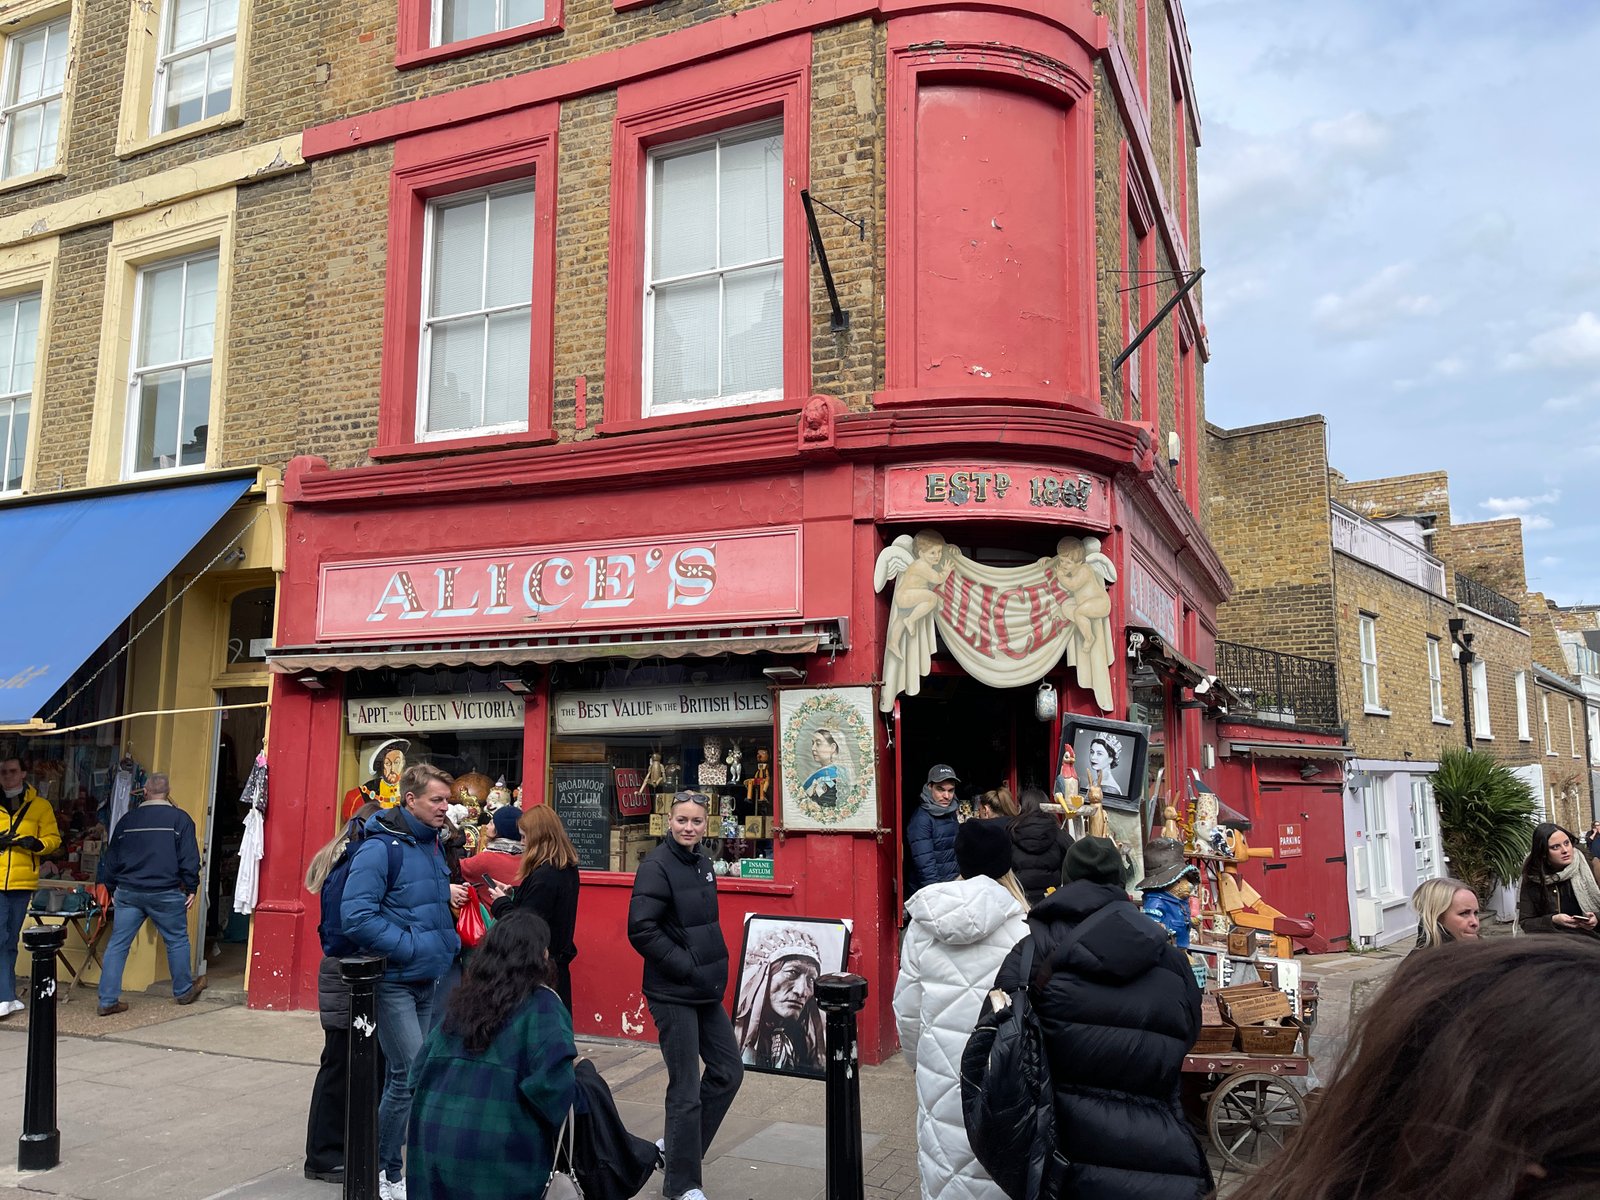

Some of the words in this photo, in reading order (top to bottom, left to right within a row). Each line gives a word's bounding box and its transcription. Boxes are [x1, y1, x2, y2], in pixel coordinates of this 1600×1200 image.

[366, 541, 718, 622] ALICE'S
[560, 708, 575, 716] THE
[577, 701, 608, 719] BEST
[611, 698, 653, 717] VALUE
[655, 704, 662, 712] IN
[664, 703, 677, 711] THE
[679, 694, 730, 714] BRITISH
[733, 691, 769, 711] ISLES
[357, 705, 390, 724] APPT.
[403, 702, 446, 727] QUEEN
[451, 700, 516, 720] VICTORIA
[557, 778, 605, 793] BROADMOOR
[559, 792, 601, 804] ASYLUM
[622, 793, 648, 807] CLUB
[567, 818, 593, 826] OFFICE
[1286, 826, 1294, 835] NO
[1279, 836, 1301, 845] PARKING
